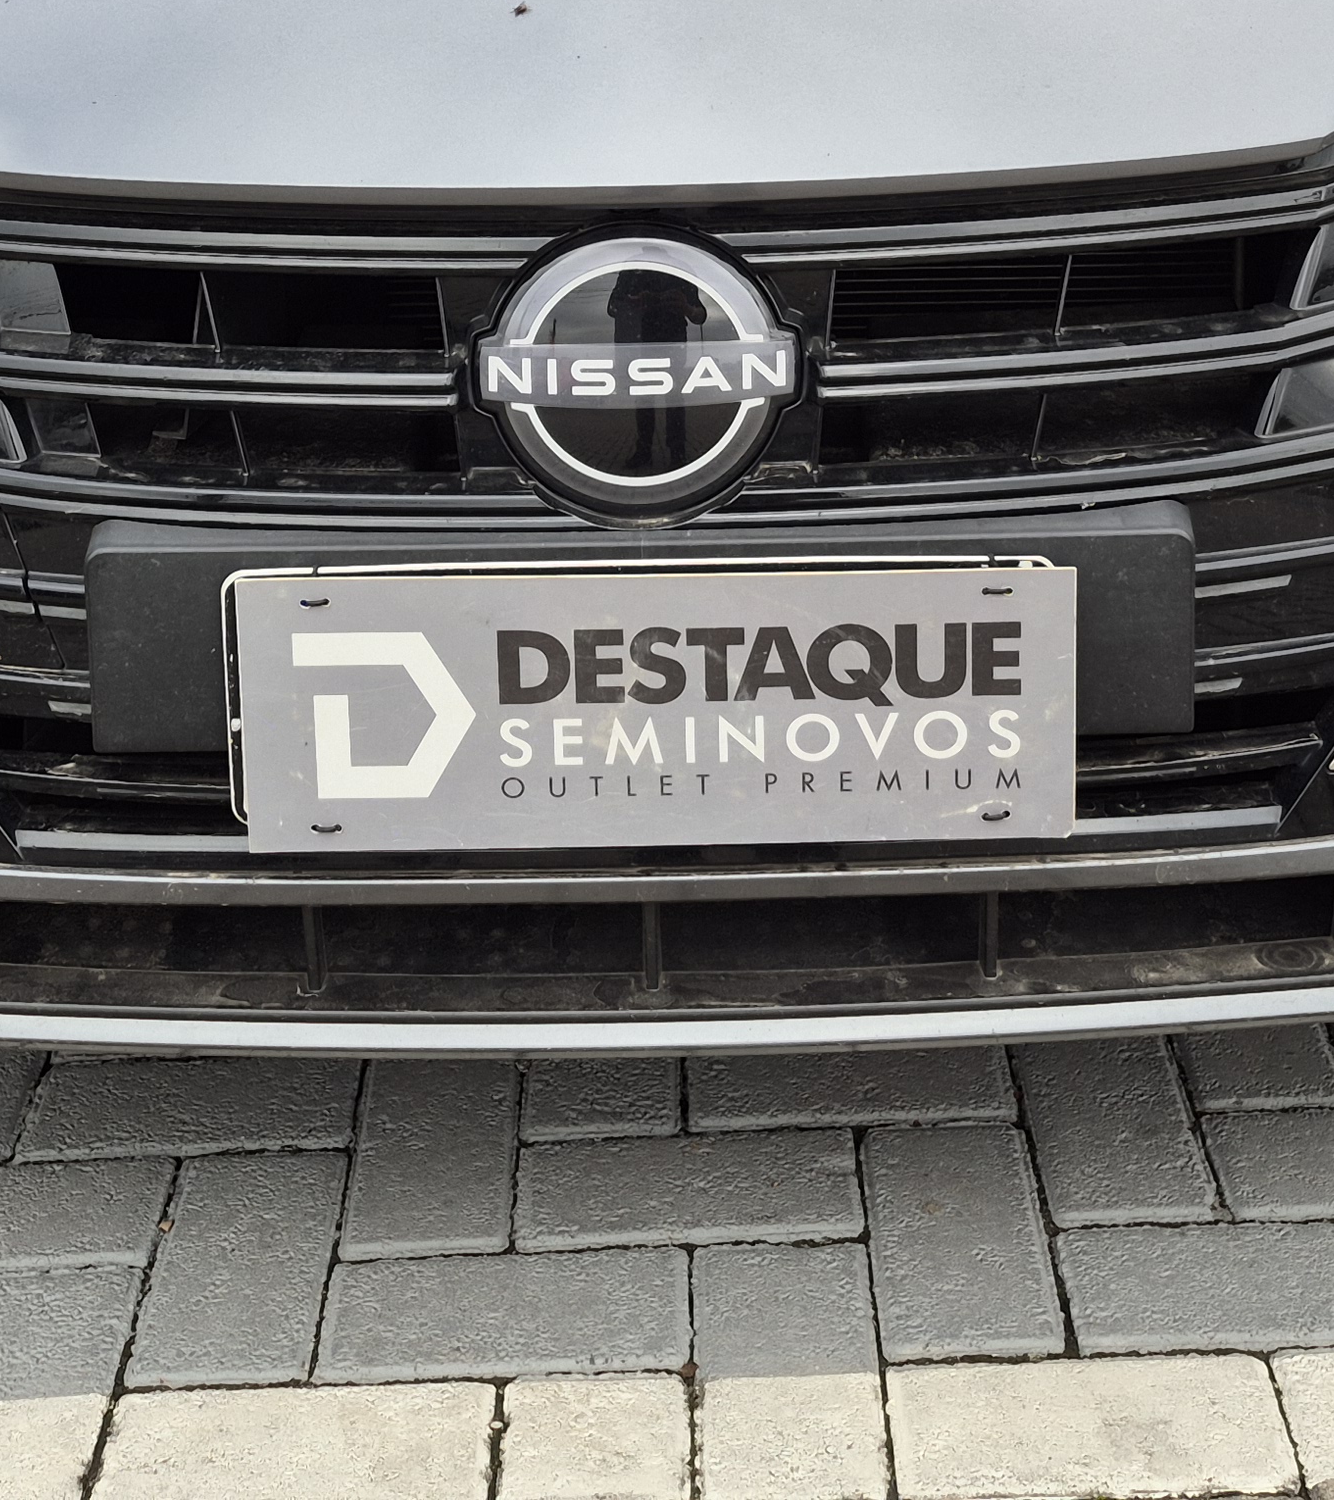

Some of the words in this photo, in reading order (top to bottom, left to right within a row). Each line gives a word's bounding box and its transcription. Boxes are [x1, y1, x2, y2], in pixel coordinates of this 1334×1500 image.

[488, 349, 787, 397] NISSAN
[496, 621, 1022, 707] DESTAQUE
[499, 710, 1022, 767] SEMINOVOS
[500, 773, 712, 800] OUTLET
[765, 768, 1023, 795] PREMIUM
